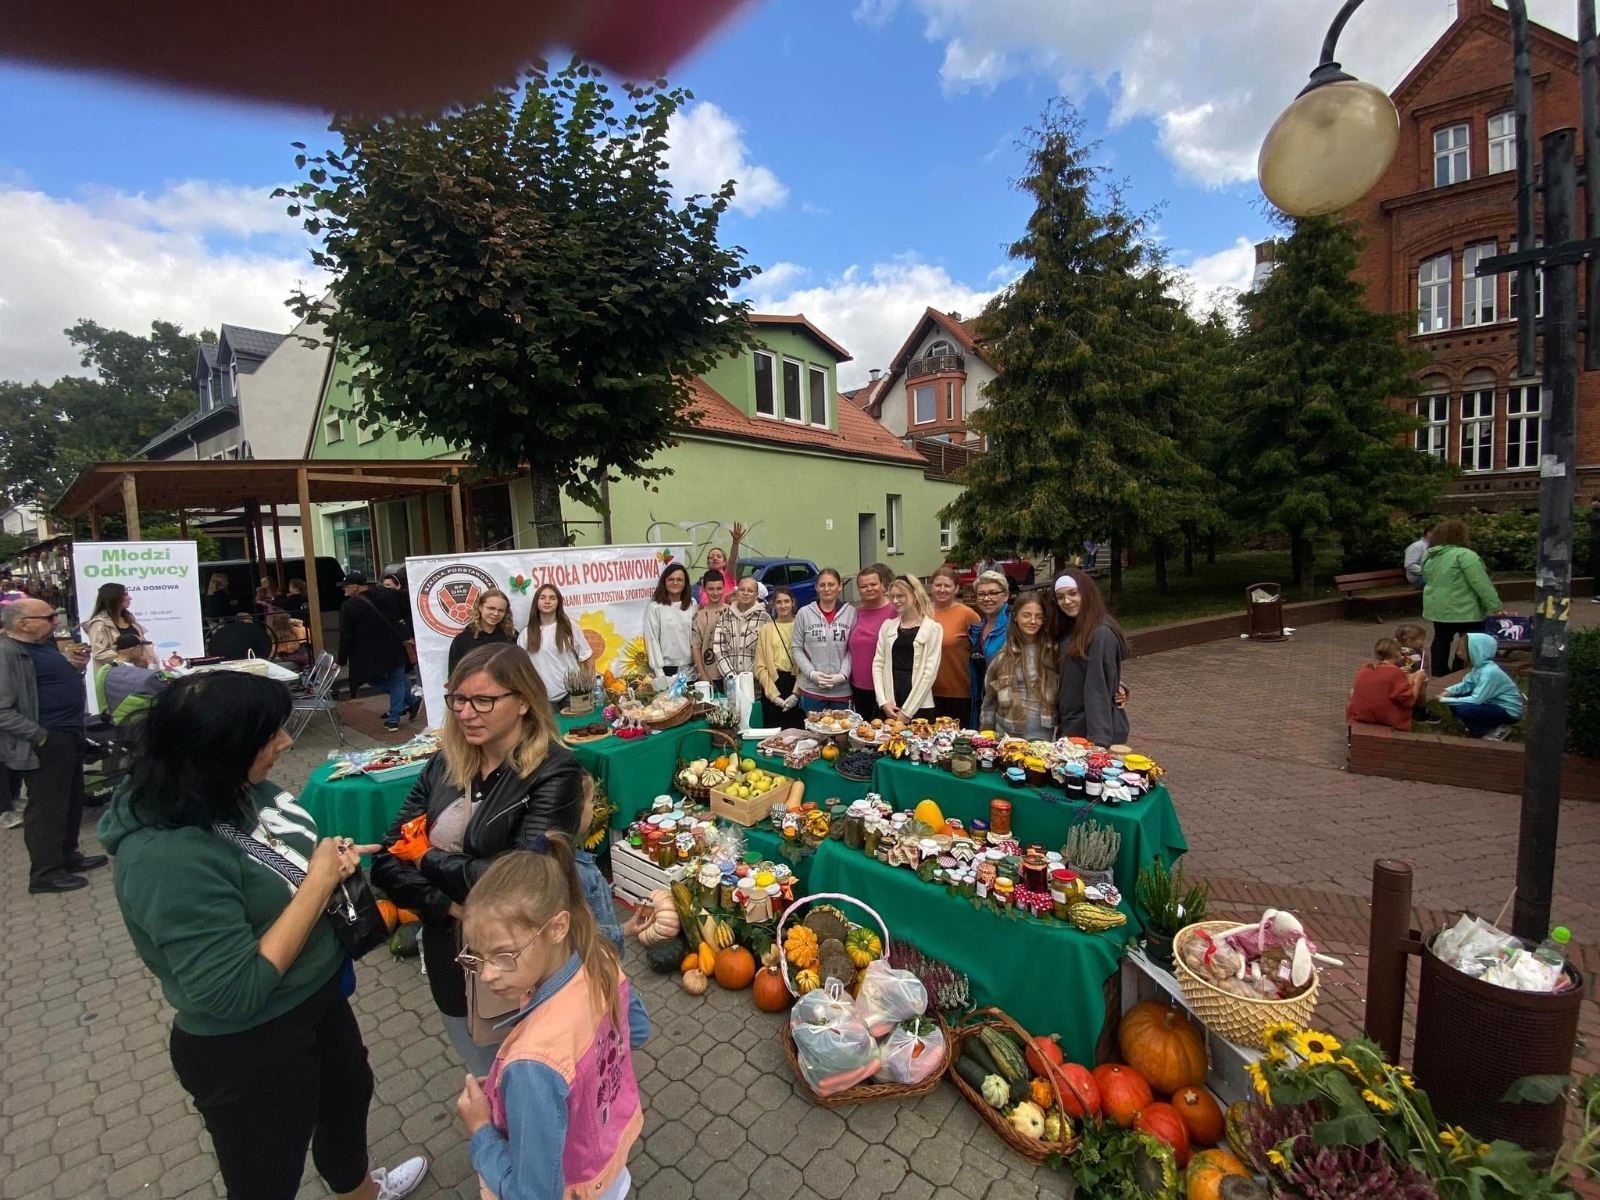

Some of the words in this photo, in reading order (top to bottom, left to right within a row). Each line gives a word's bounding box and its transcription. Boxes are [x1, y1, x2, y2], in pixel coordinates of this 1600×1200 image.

[102, 548, 171, 562] Młodzi
[83, 564, 189, 579] Odkrywcy
[424, 572, 446, 592] SZKOŁA
[446, 566, 492, 587] PODSTAWOWA
[531, 564, 580, 589] SZKOŁA
[583, 558, 660, 584] PODSTAWOWA
[562, 595, 581, 607] AŁAMI
[583, 589, 624, 604] MISTRZOSTWA
[624, 586, 657, 599] SPORTOWEG
[1536, 595, 1570, 621] 42
